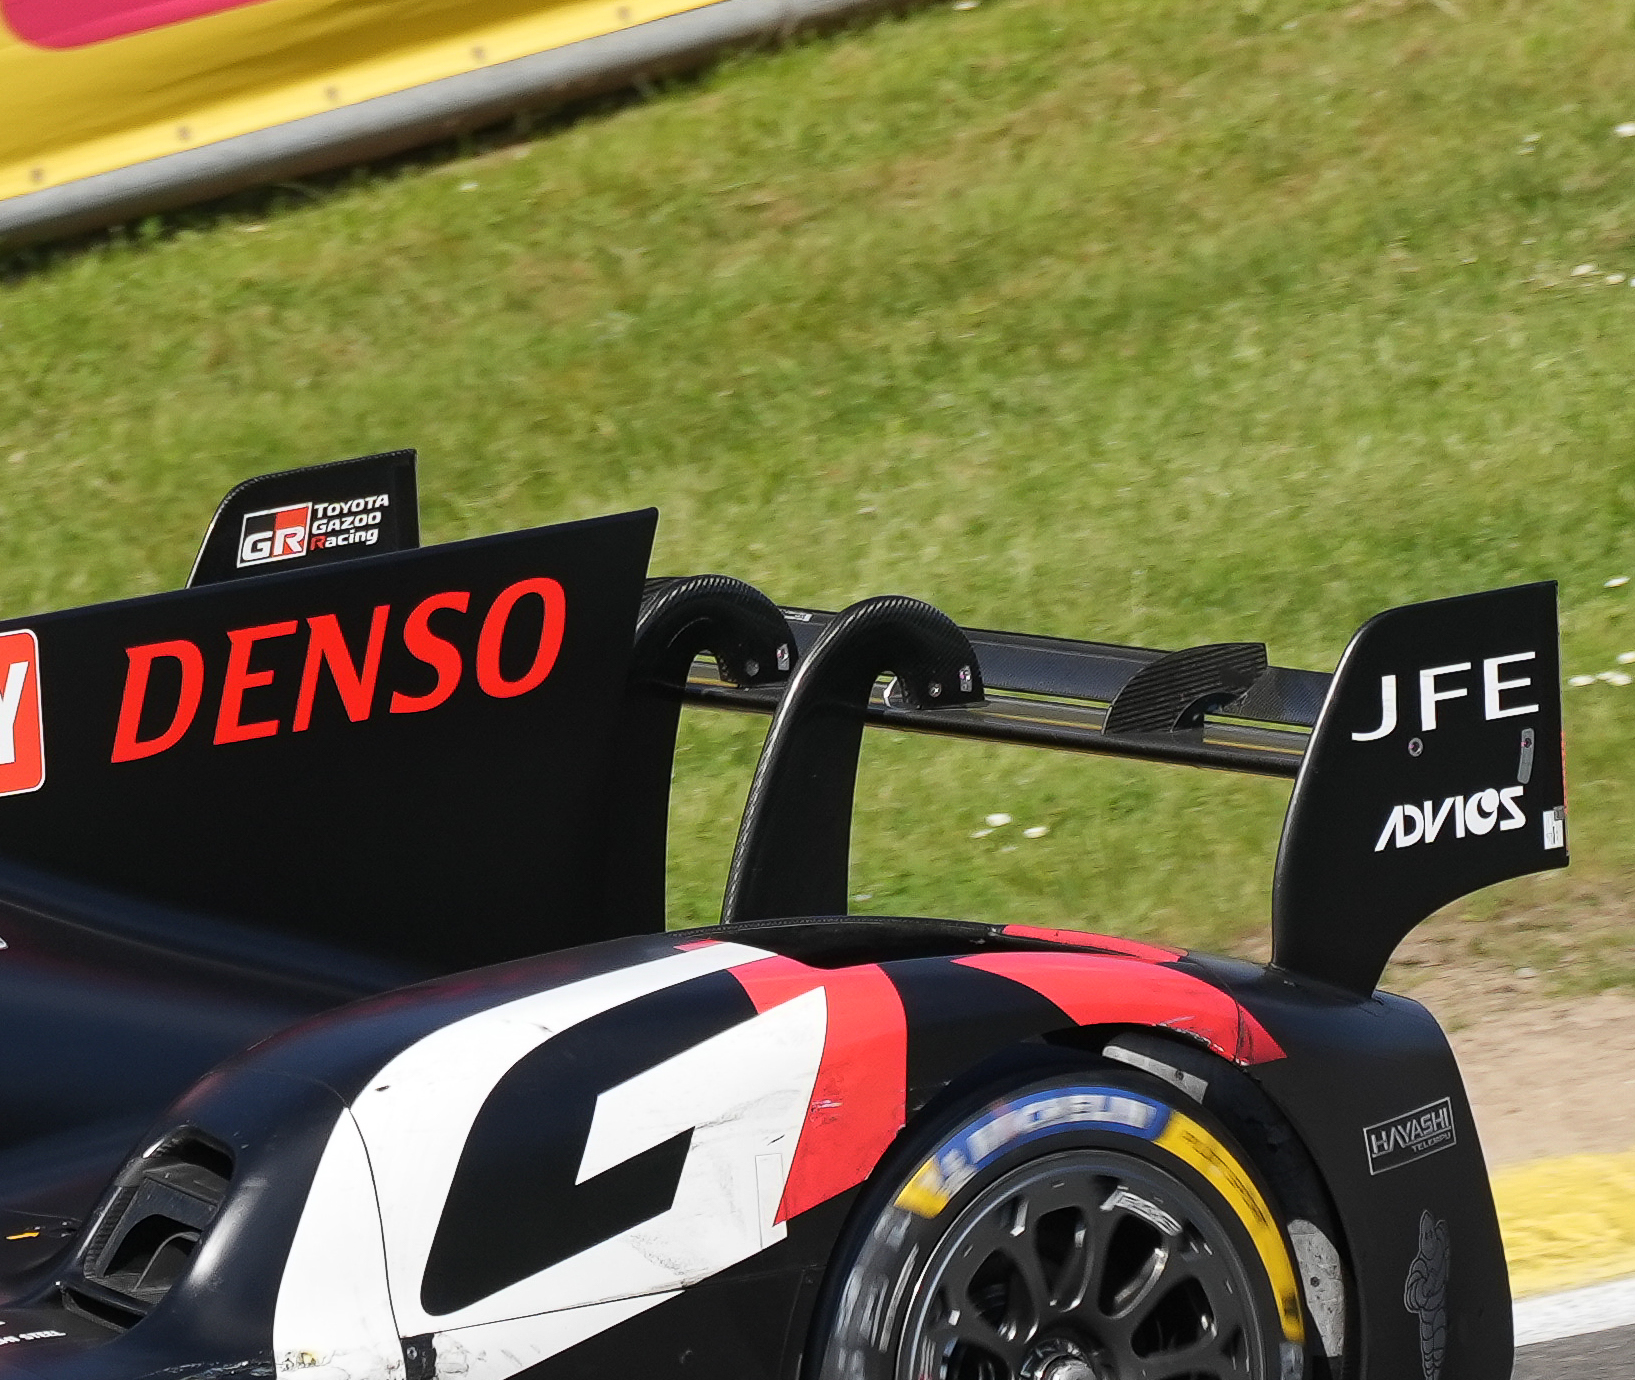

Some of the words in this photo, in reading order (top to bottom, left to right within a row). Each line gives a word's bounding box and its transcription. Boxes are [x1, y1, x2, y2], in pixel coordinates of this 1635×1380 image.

[311, 511, 381, 535] GAZOO
[314, 493, 389, 518] TOYOTA
[241, 525, 304, 561] GR
[310, 527, 379, 551] Racing
[110, 577, 566, 763] DENSO
[1351, 651, 1539, 741] JFE
[1370, 1106, 1450, 1154] HAYASHI
